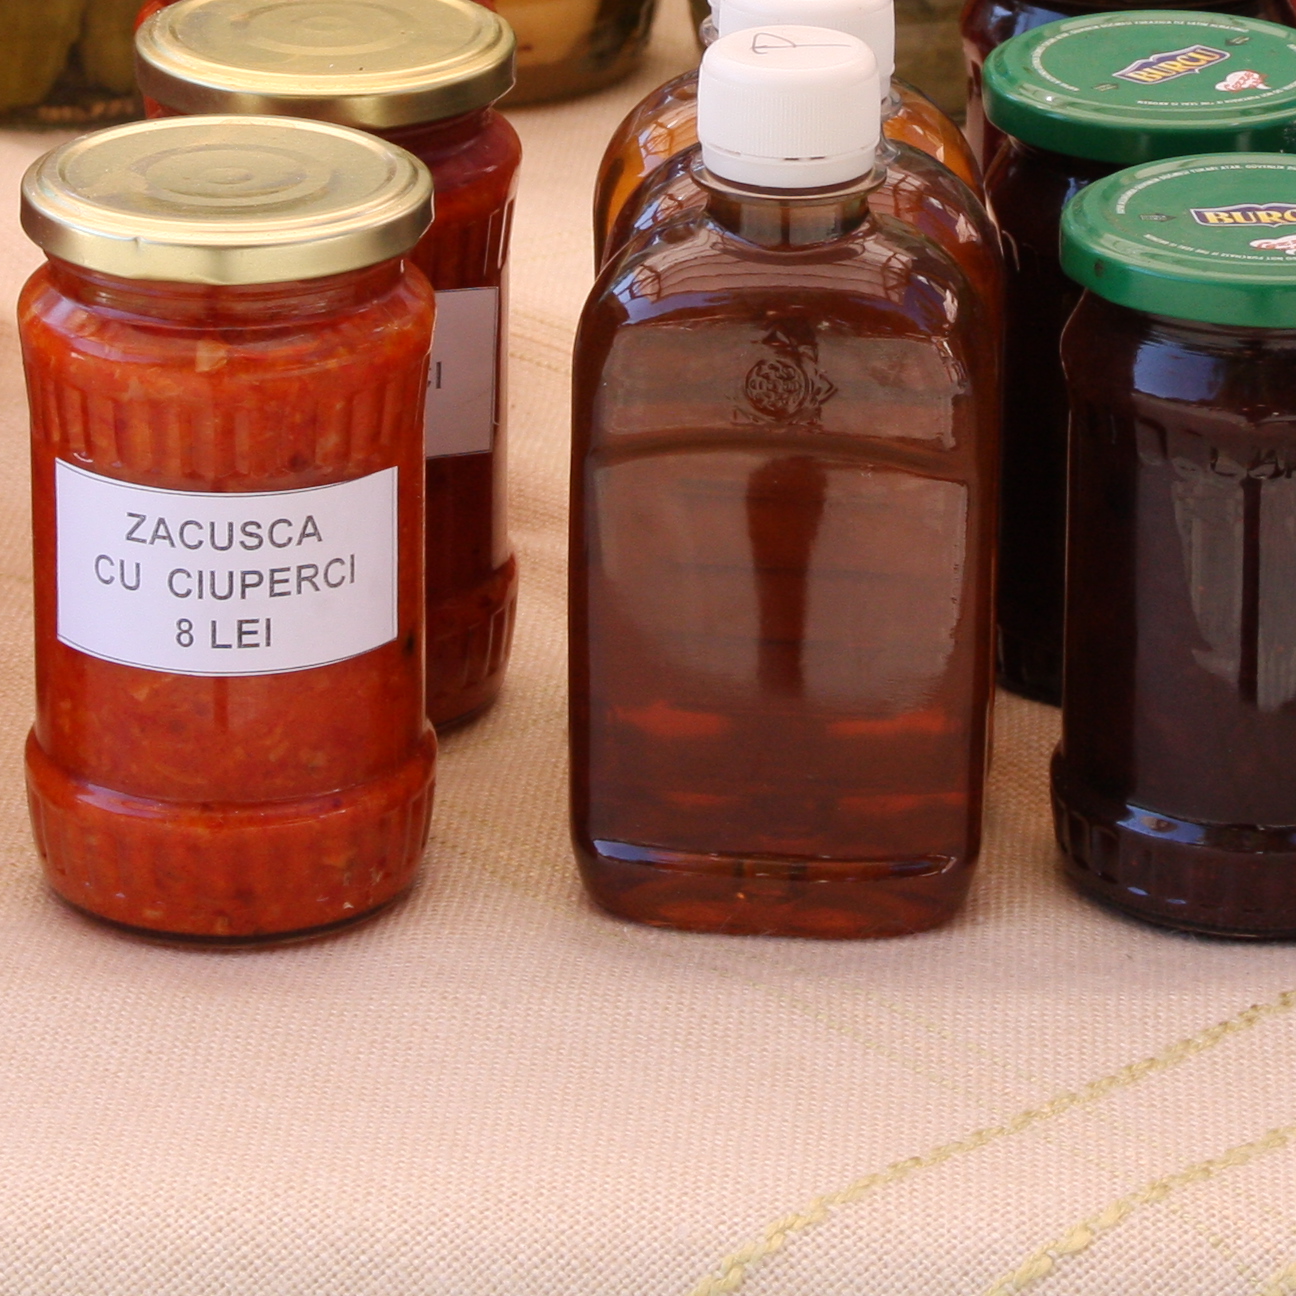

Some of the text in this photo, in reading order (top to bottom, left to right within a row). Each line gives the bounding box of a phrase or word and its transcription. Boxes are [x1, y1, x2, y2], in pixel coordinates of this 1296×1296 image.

[1126, 48, 1221, 83] BURCU
[125, 511, 323, 551] ZACUSCA
[94, 553, 356, 601] CU CIUPERCI
[175, 617, 272, 649] 8 LEI
